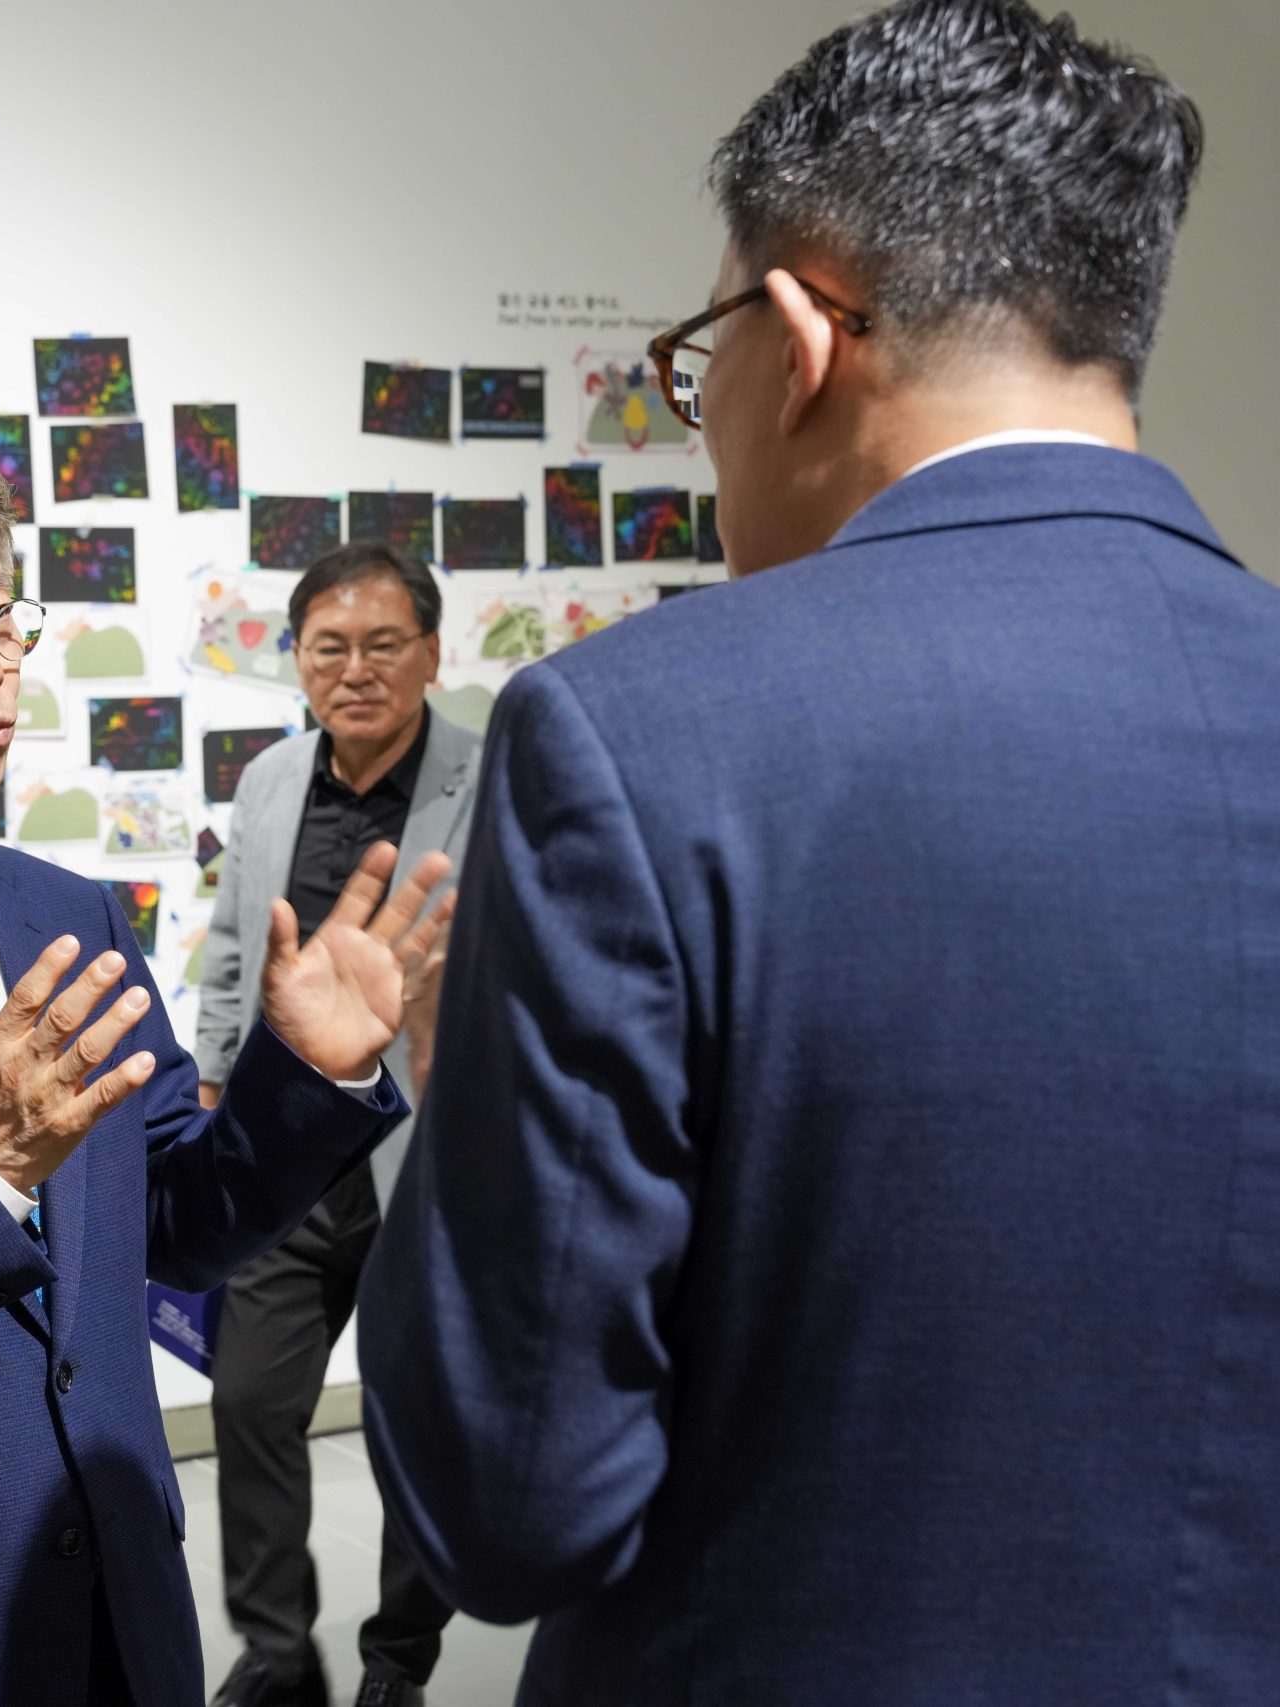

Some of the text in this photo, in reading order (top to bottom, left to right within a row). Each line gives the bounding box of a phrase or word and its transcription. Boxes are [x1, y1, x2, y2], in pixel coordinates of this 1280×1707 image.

[524, 314, 547, 330] free
[551, 315, 562, 327] to
[566, 316, 593, 328] write
[598, 319, 623, 331] your
